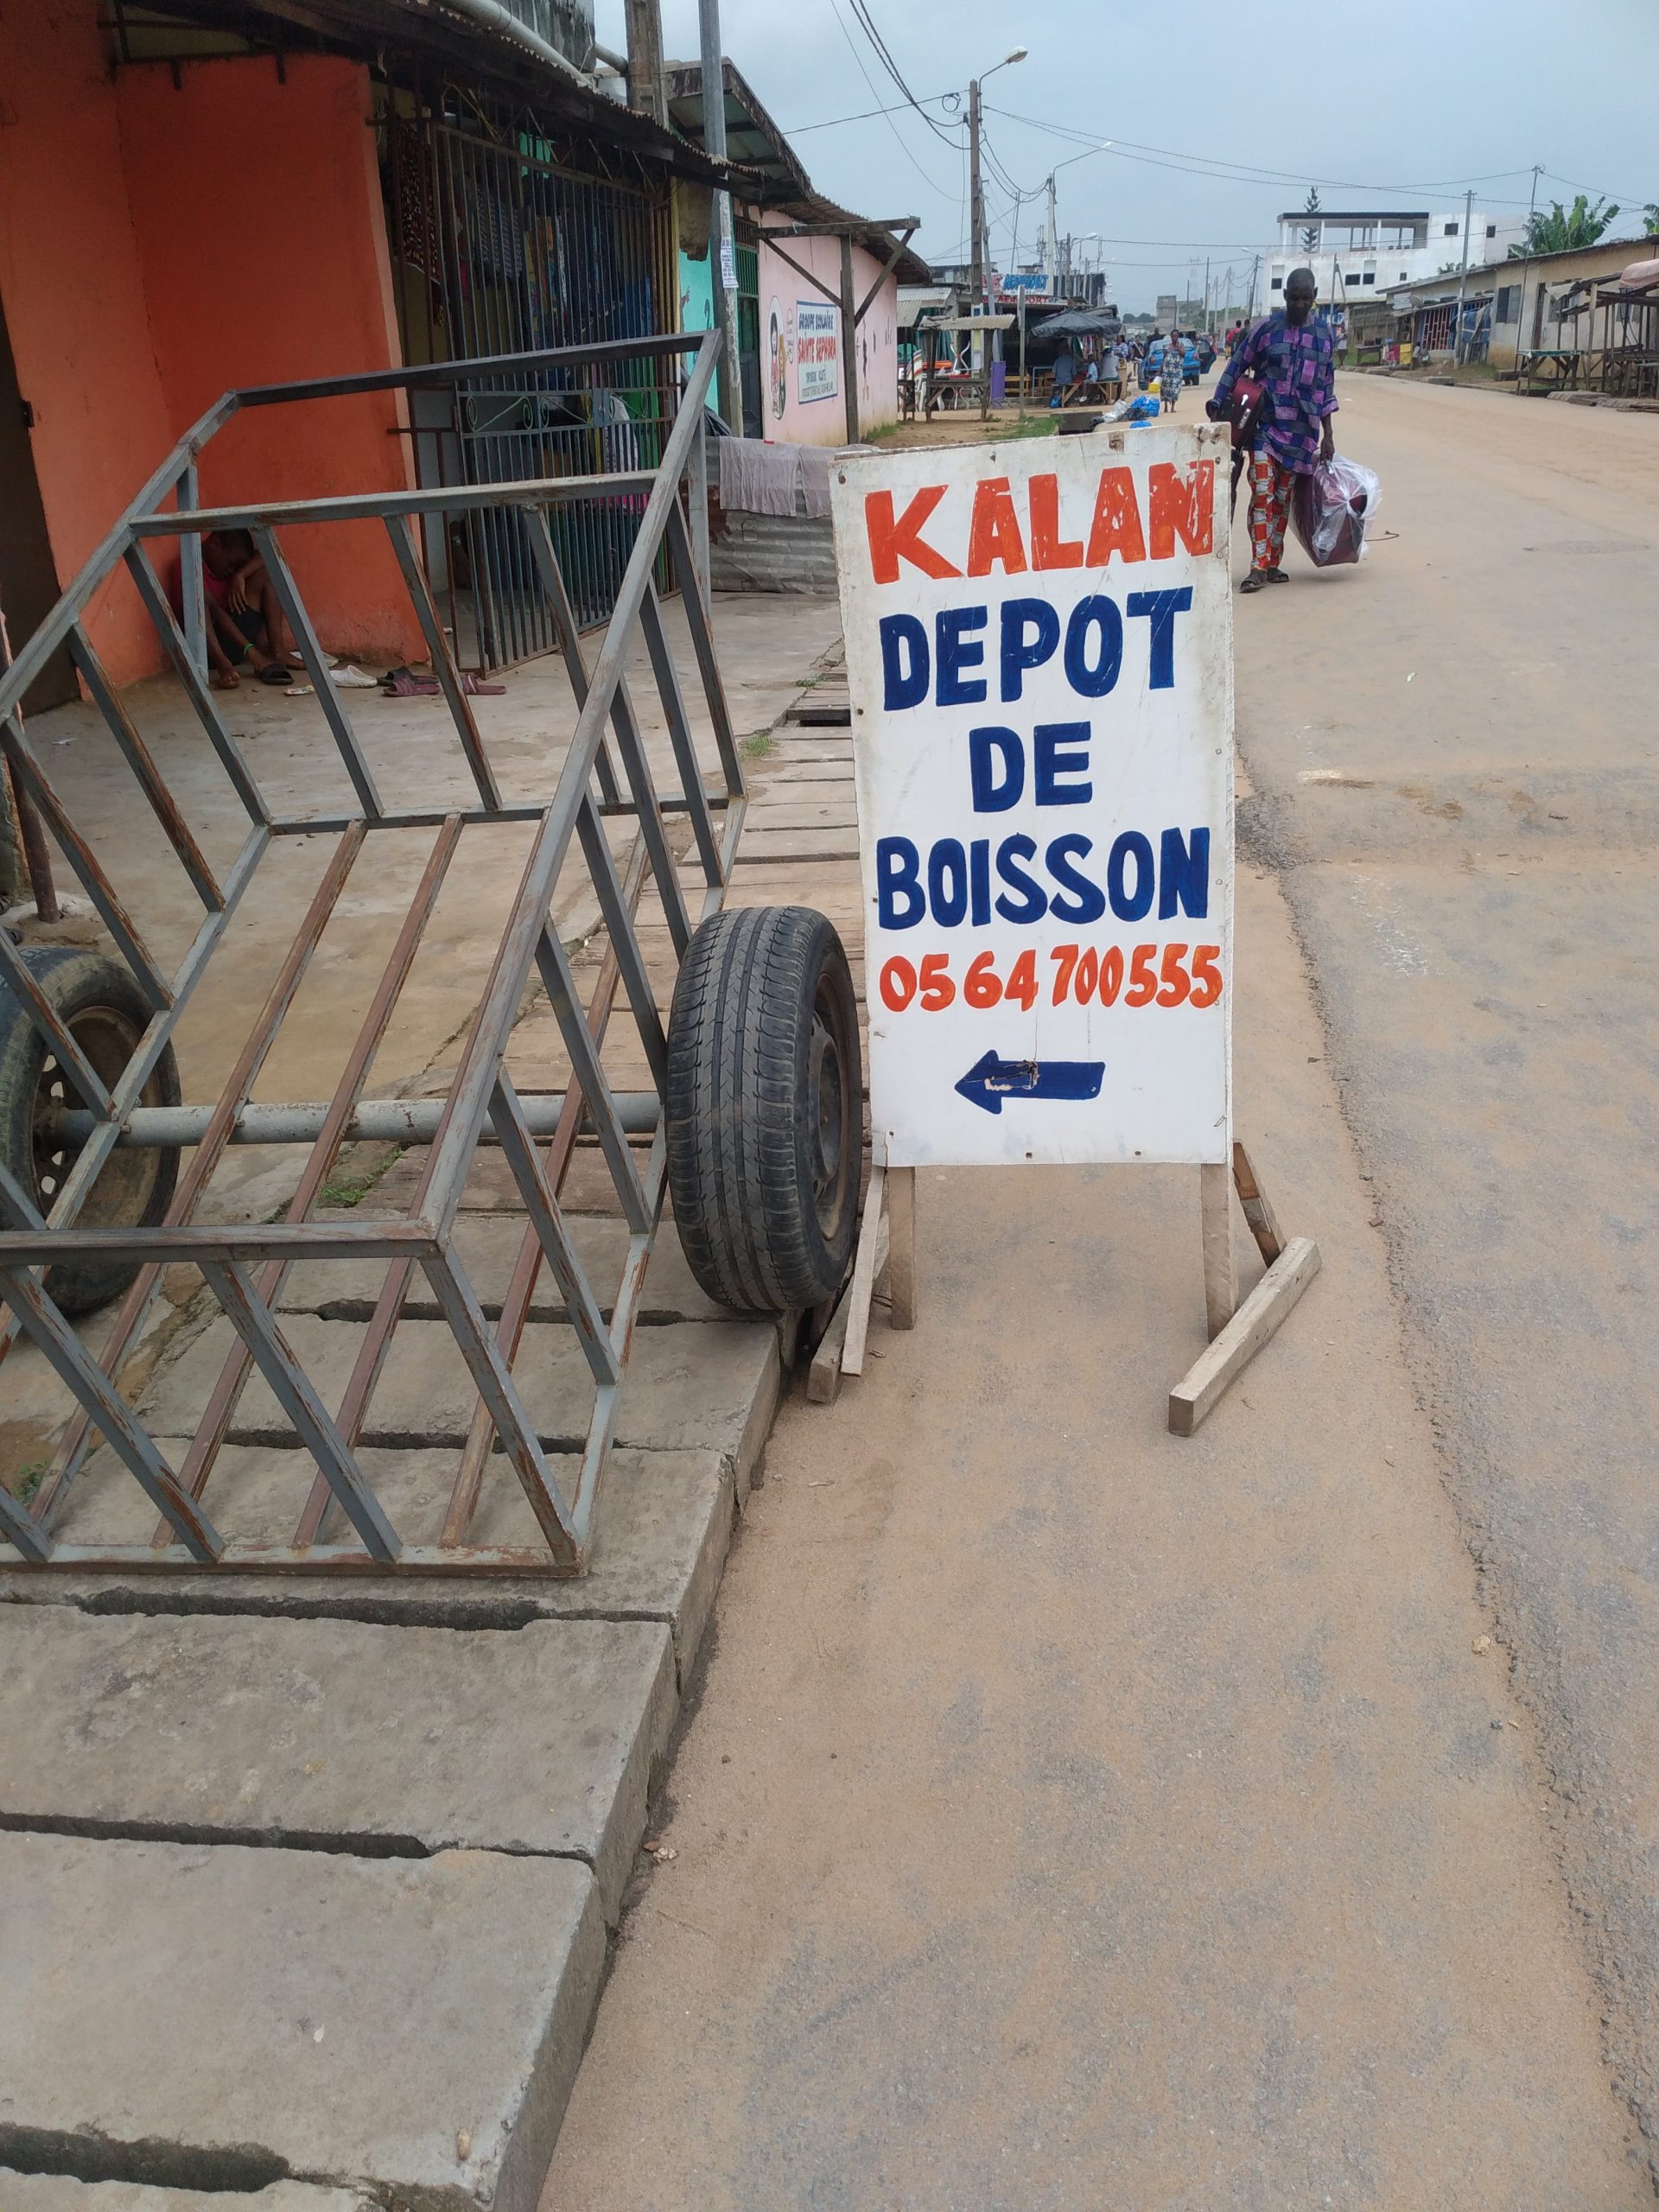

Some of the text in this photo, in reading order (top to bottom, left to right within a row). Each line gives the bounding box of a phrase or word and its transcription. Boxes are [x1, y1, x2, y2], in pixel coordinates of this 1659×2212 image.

[864, 459, 1215, 585] KALAN
[879, 586, 1193, 711] DEPOT
[969, 721, 1092, 813] DE
[876, 826, 1210, 931] BOISSON
